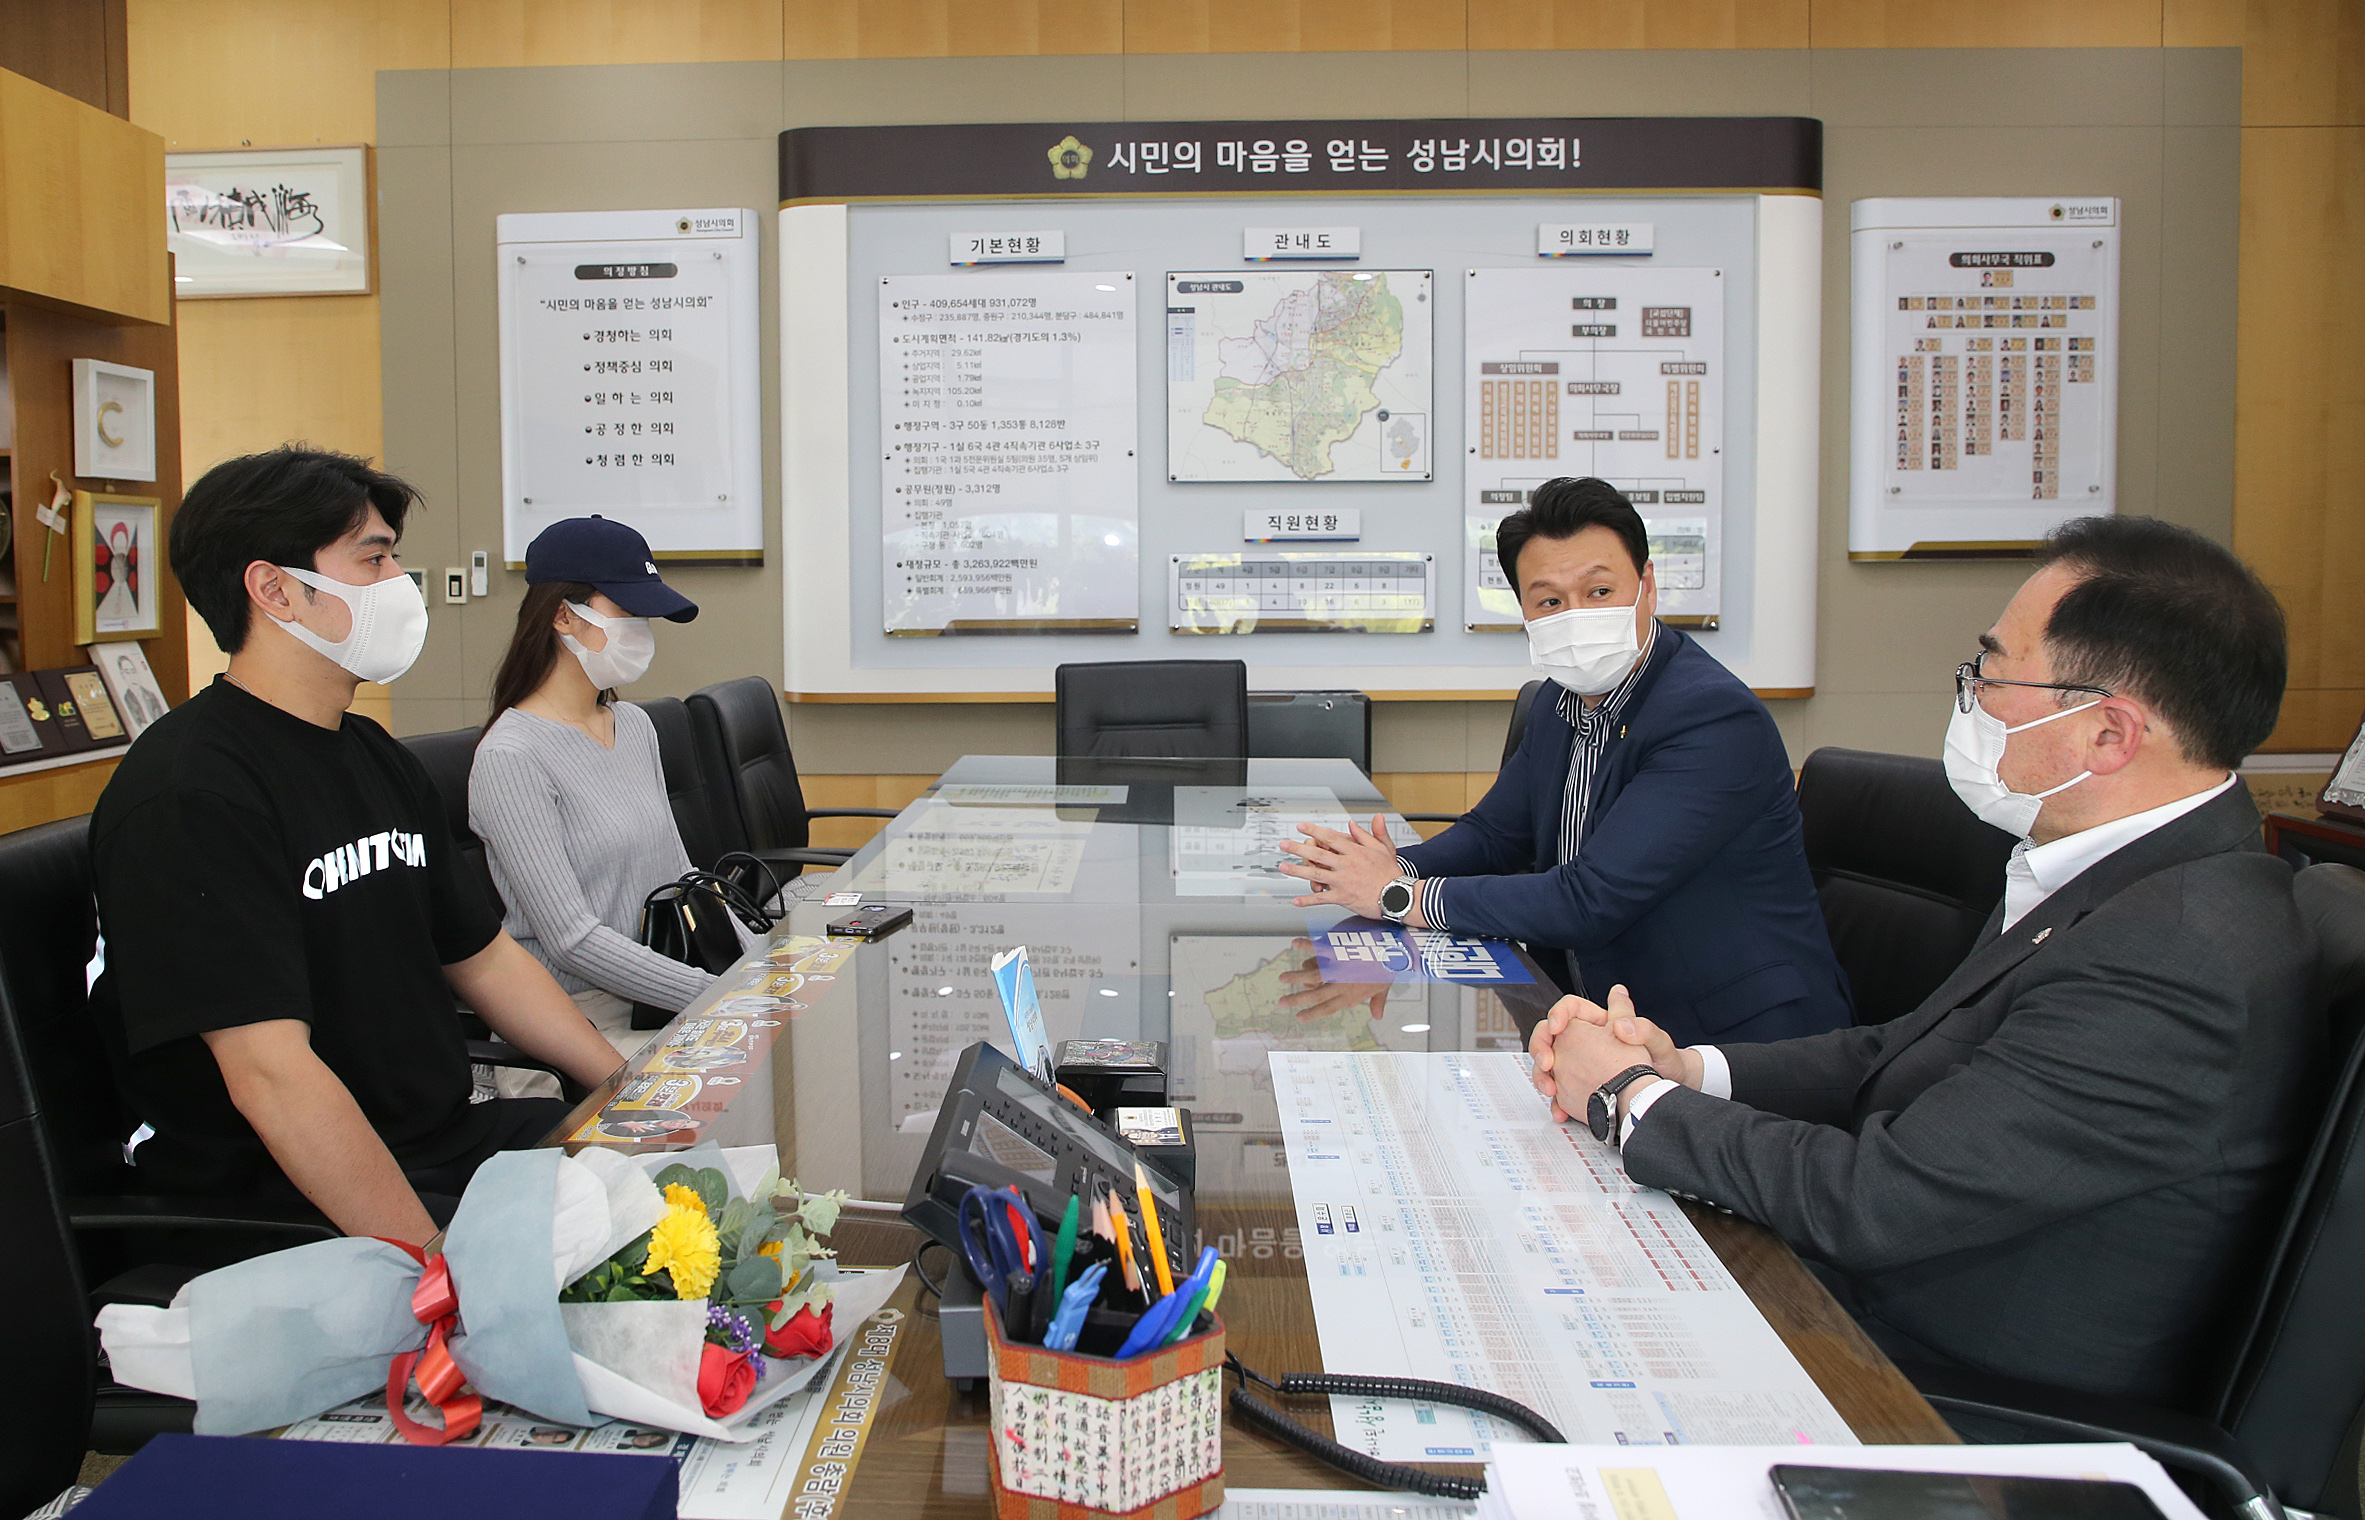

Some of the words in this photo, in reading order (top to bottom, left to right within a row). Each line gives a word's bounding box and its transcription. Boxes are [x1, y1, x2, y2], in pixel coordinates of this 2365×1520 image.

[1107, 141, 1201, 174] 시민의
[1216, 140, 1312, 173] 마음을
[1325, 139, 1390, 173] 얻는
[1405, 137, 1582, 172] 성남시의회!
[695, 218, 735, 228] 성남시의회
[1274, 232, 1332, 250] 관내도
[1560, 229, 1630, 246] 의회현황
[970, 236, 1041, 255] 기본현황
[1961, 254, 2010, 266] 의회사무국
[603, 265, 650, 278] 의정방침
[584, 297, 618, 311] 마음을
[623, 298, 645, 310] 얻는
[902, 298, 920, 309] 인구
[929, 297, 987, 309] 409,654세대
[989, 297, 1037, 308] 931,072명
[593, 329, 641, 343] 경청하는
[648, 328, 673, 342] 의회
[902, 333, 957, 344] 도시계획면적
[1052, 332, 1081, 343] 1.3%)
[594, 360, 642, 374] 정책중심
[649, 359, 673, 373] 의회
[649, 390, 674, 404] 의회
[650, 421, 674, 435] 의회
[903, 420, 940, 431] 행정구역
[950, 420, 964, 431] 3구
[967, 419, 988, 431] 50동
[991, 419, 1026, 430] 1,353통
[1029, 419, 1066, 430] 8,128반
[904, 441, 941, 452] 행정기구
[950, 441, 965, 452] 1실
[967, 441, 982, 451] 6국
[985, 440, 1001, 451] 4관
[1003, 440, 1046, 451] 4직속기관
[1049, 440, 1081, 450] 6사업소
[1085, 440, 1100, 450] 3구
[651, 452, 675, 466] 의회
[904, 484, 956, 495] 공무원(정원)
[965, 483, 1001, 494] 3,312명
[1267, 514, 1339, 532] 직원현황
[905, 559, 941, 569] 재정규모
[951, 559, 960, 569] 총
[860, 1323, 898, 1357] 제8대
[831, 1359, 885, 1426] 성남시의회
[817, 1426, 859, 1459] 의원
